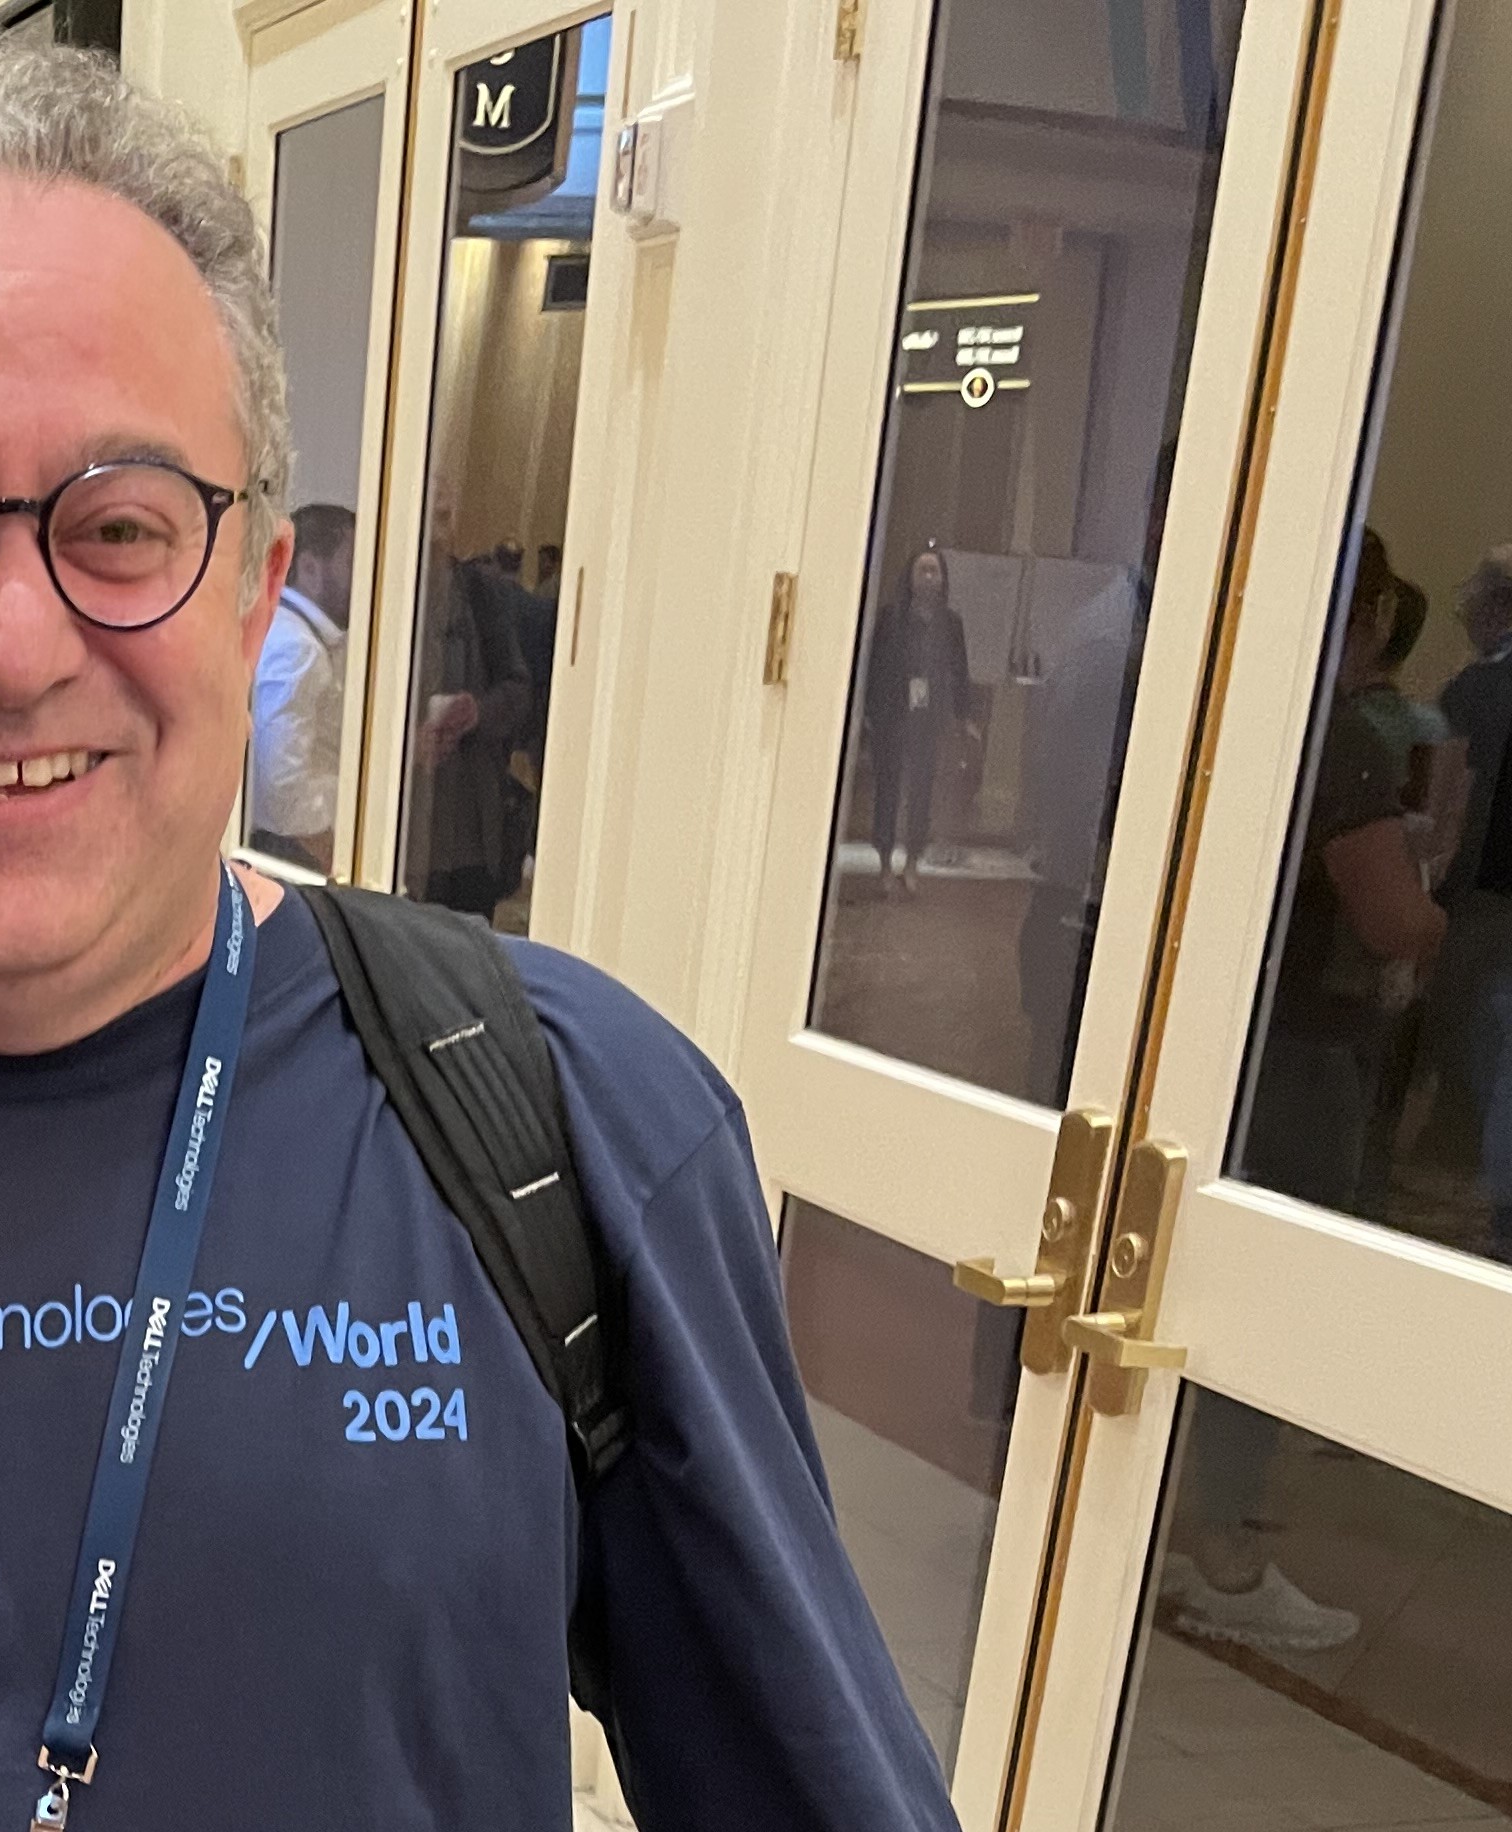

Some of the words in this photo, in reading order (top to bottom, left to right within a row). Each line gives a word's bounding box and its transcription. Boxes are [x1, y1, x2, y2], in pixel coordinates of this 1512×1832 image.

[196, 1055, 223, 1109] DELL
[143, 1296, 172, 1351] DELL
[342, 1387, 468, 1443] 2024
[89, 1558, 117, 1614] DELL
